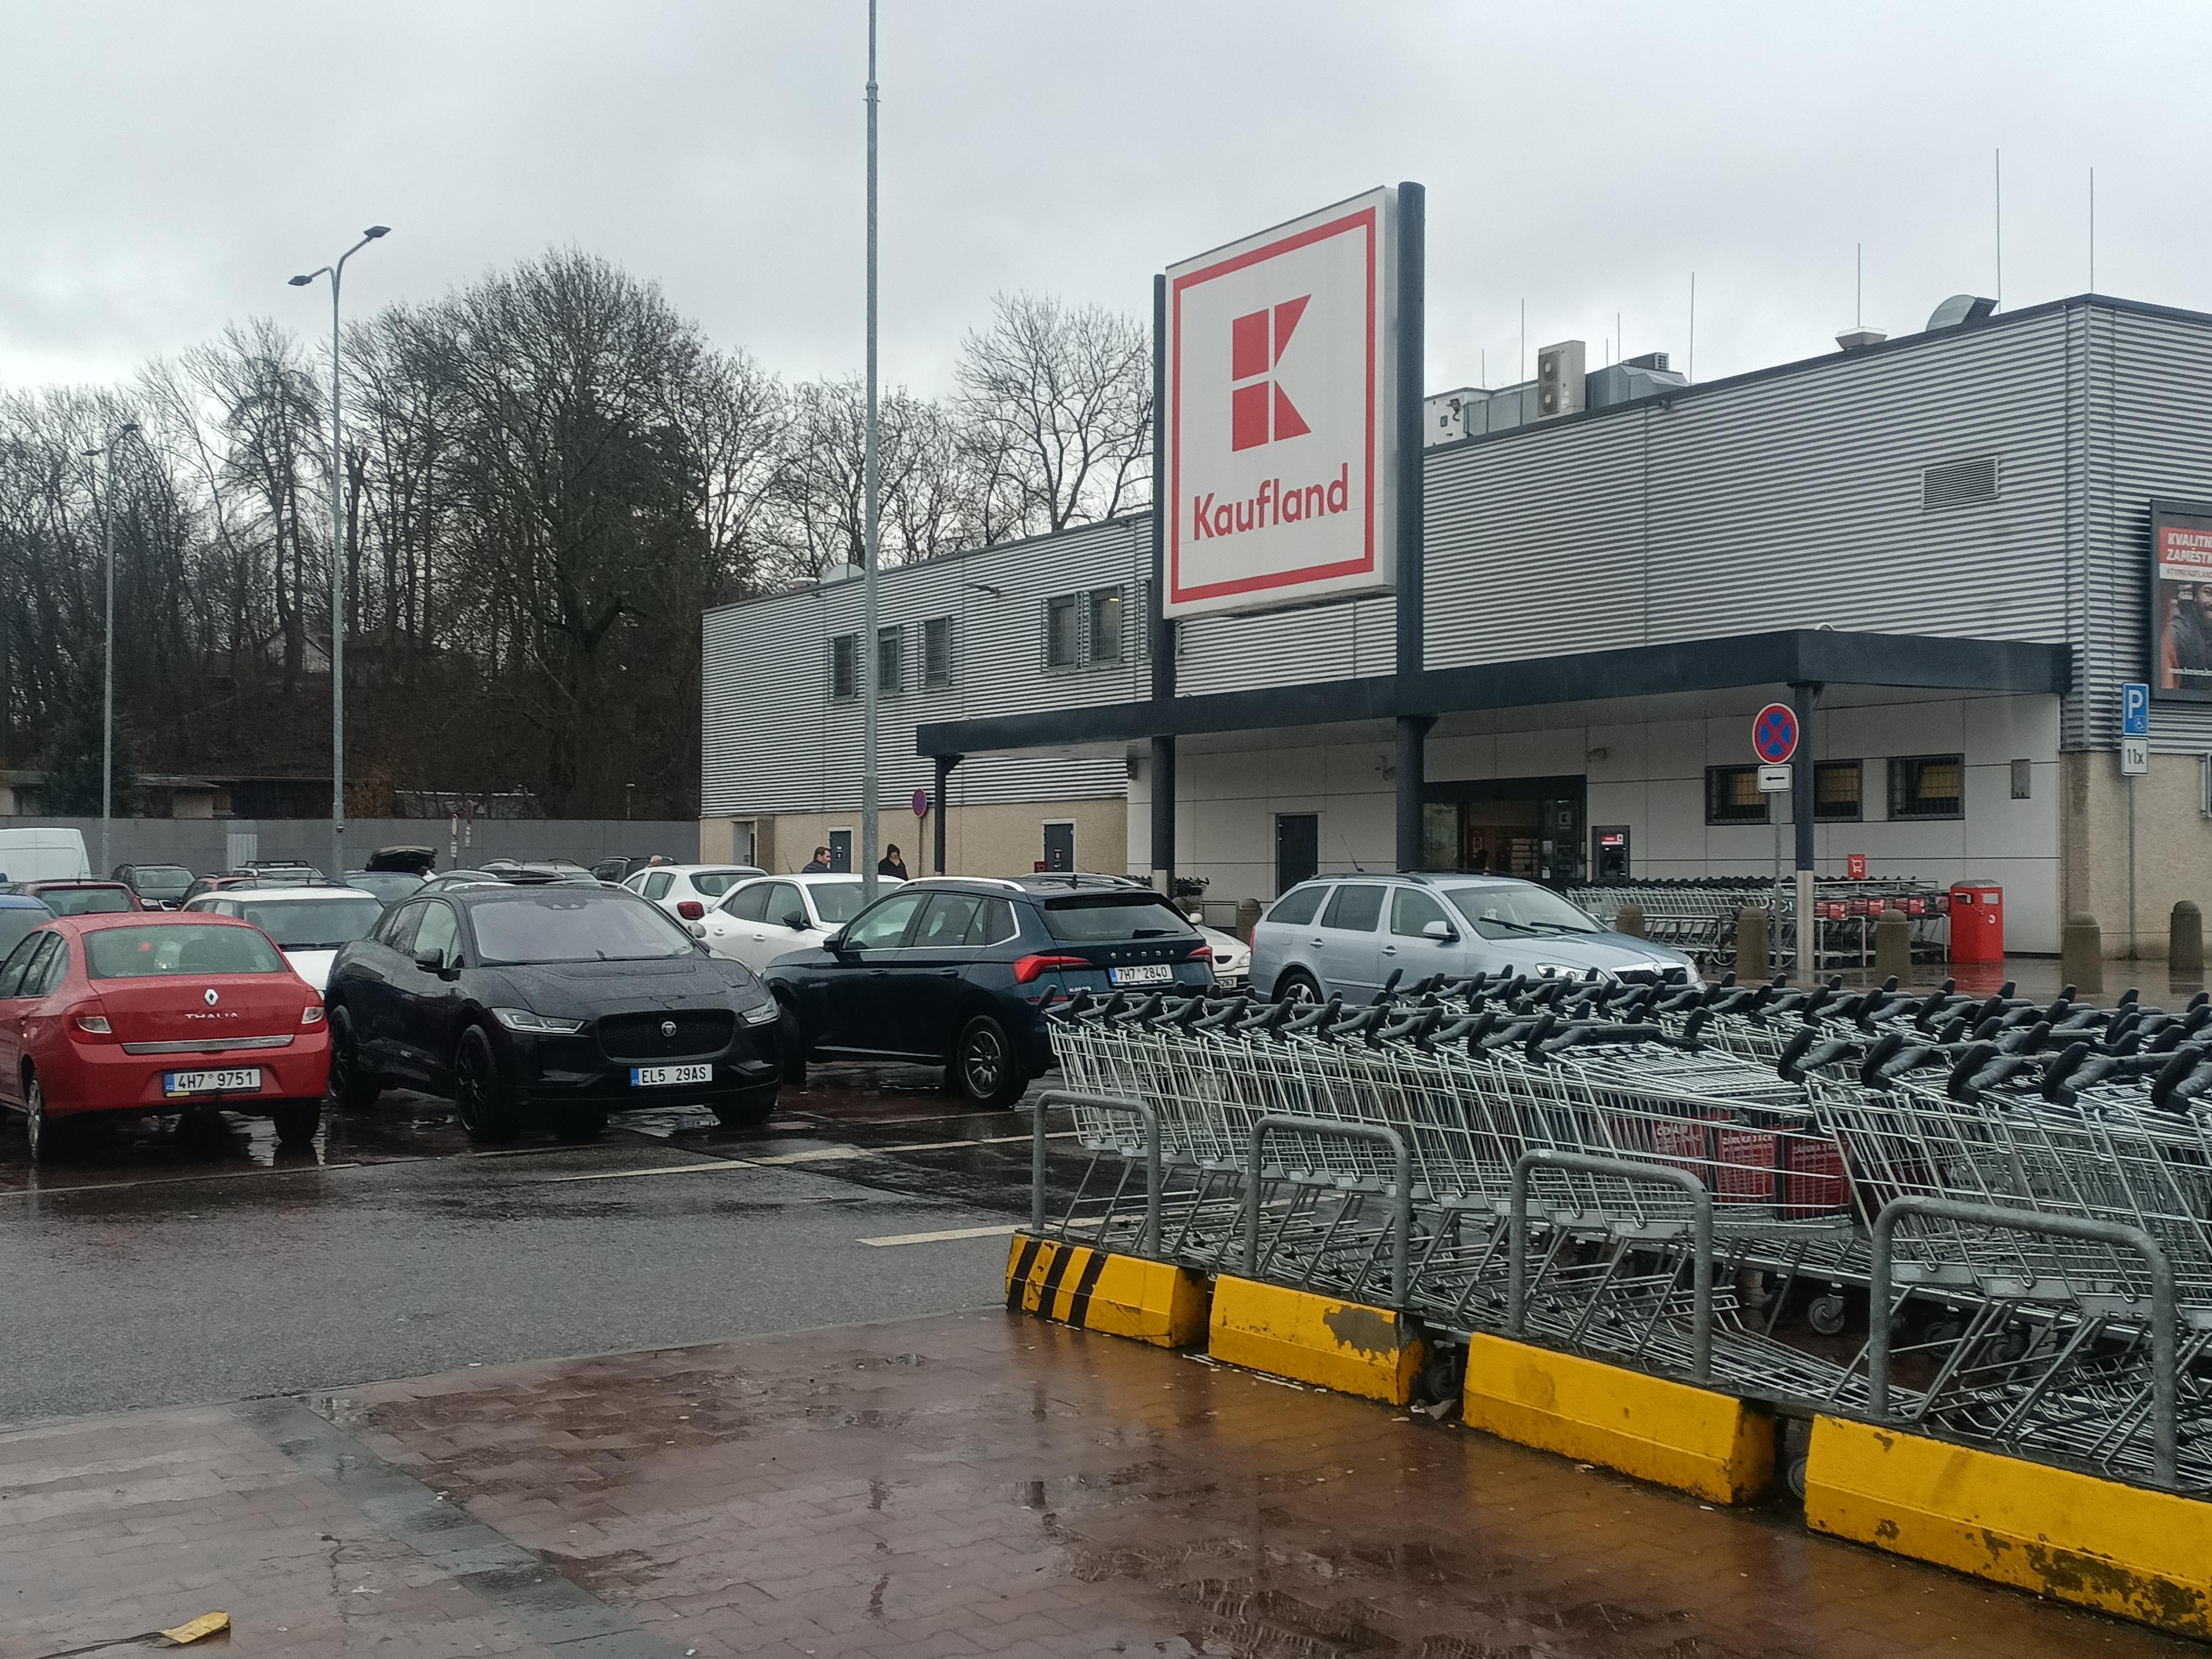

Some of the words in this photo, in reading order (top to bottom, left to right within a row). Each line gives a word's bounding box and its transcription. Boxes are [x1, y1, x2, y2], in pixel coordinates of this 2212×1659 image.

[1194, 462, 1348, 541] Kaufland
[2128, 690, 2143, 719] P
[2127, 749, 2144, 764] 11x
[1118, 968, 1135, 980] 7H7
[1143, 967, 1167, 978] 2840
[178, 1074, 205, 1089] 4H7
[217, 1071, 252, 1086] 9751
[642, 1069, 665, 1083] EL5
[676, 1066, 706, 1081] 29AS
